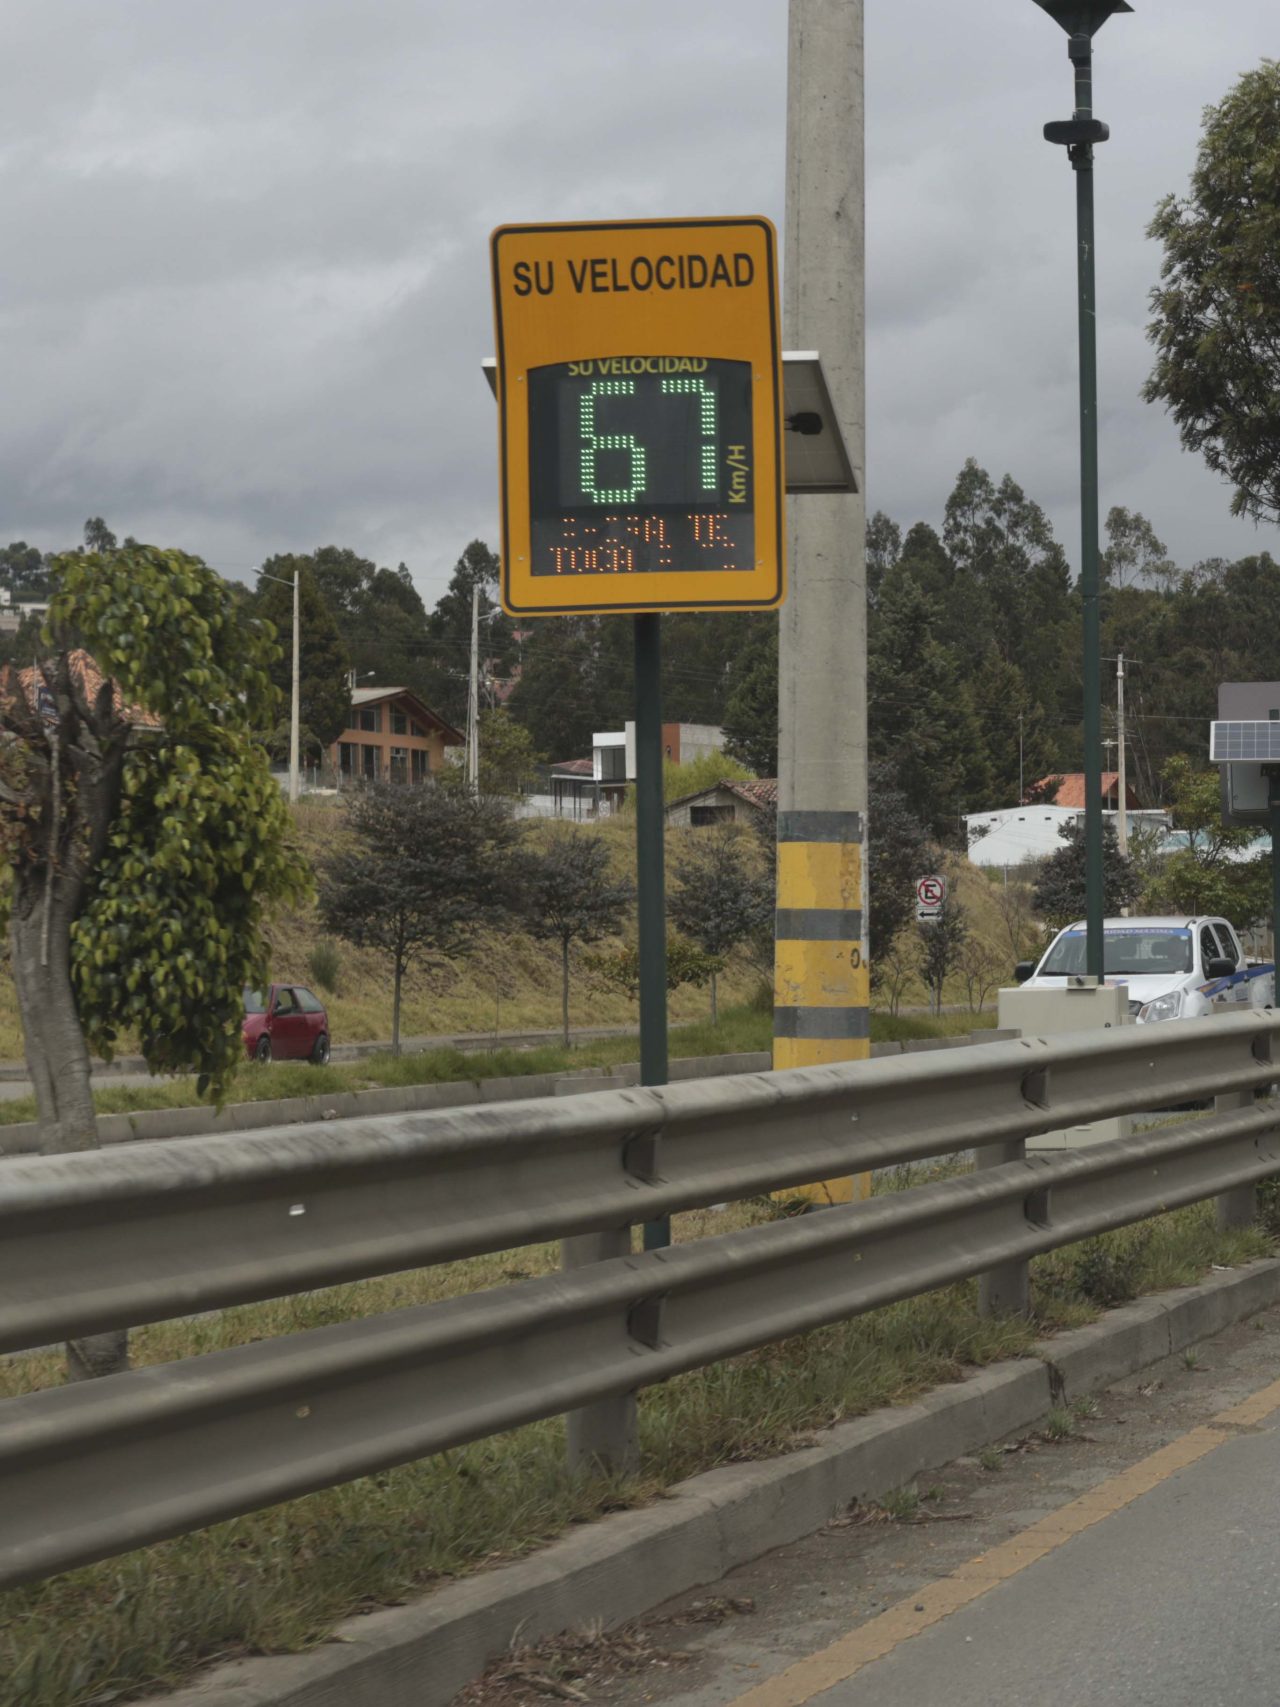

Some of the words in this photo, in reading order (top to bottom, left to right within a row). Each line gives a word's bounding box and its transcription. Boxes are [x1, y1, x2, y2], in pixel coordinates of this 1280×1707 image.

[513, 261, 554, 296] SU
[567, 252, 755, 293] VELOCIDAD
[568, 361, 593, 376] SU
[597, 356, 707, 375] VELOCIDAD
[580, 379, 716, 503] 67
[726, 445, 749, 503] Km/H
